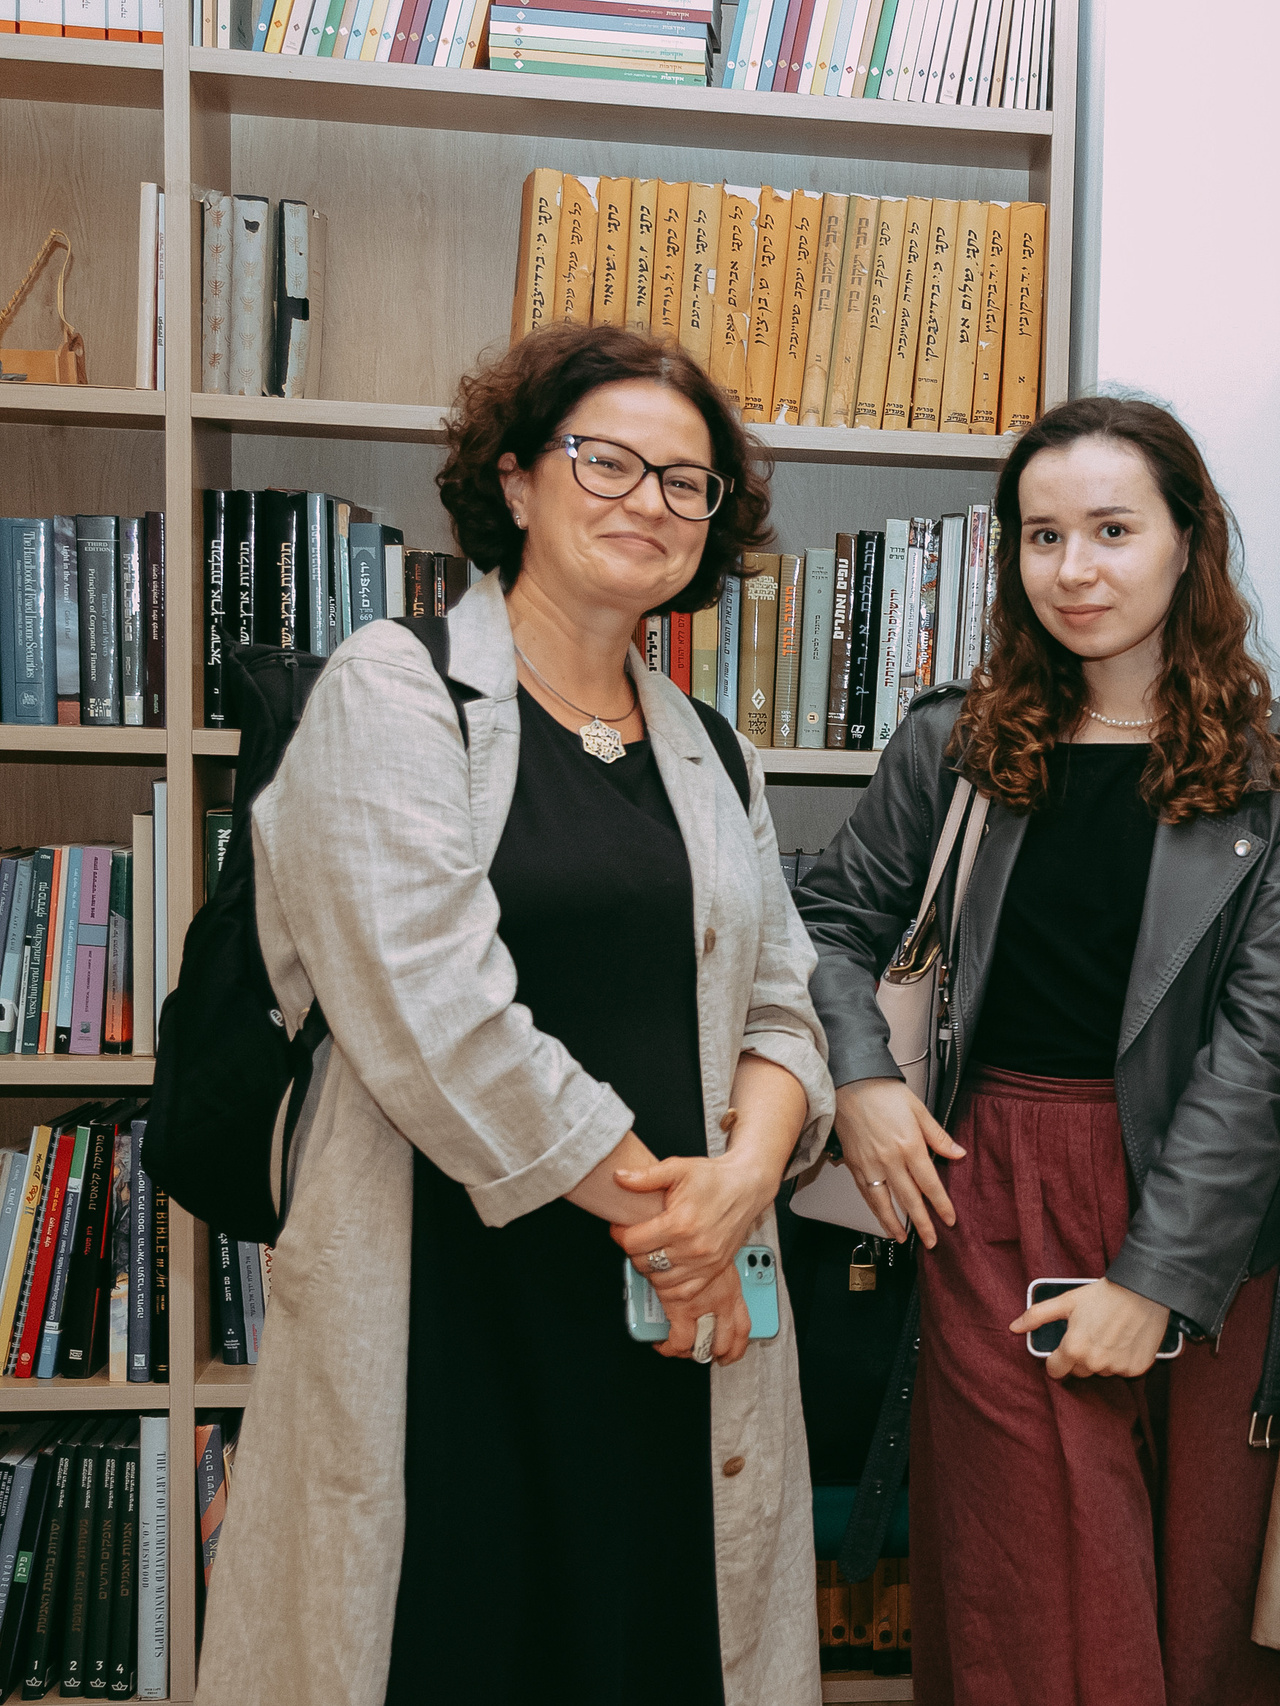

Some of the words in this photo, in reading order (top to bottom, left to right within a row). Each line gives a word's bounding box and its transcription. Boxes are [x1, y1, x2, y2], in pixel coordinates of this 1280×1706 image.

[538, 197, 550, 225] כתבי
[570, 203, 582, 216] כל
[608, 204, 619, 234] כתבי
[640, 206, 652, 235] כתבי
[664, 209, 679, 222] כל
[693, 210, 707, 223] כל
[729, 206, 743, 221] כל
[760, 214, 774, 230] כל
[571, 223, 583, 245] כתבי
[795, 218, 809, 231] כל
[879, 222, 890, 246] כתבי
[909, 222, 920, 236] כל
[666, 229, 679, 258] כתבי
[695, 229, 708, 255] כתבי
[731, 225, 744, 253] כתבי
[761, 237, 775, 268] כתבי
[797, 236, 809, 262] כתבי
[908, 240, 919, 265] כתבי
[936, 227, 949, 255] כתבי
[967, 230, 980, 260] כתבי
[991, 231, 1002, 259] כתבי
[1022, 233, 1035, 260] כתבי
[727, 260, 740, 307] אברהם
[794, 268, 805, 300] יעקב
[875, 256, 886, 287] יעקב
[902, 270, 913, 303] יהודה
[958, 269, 975, 310] שלום
[959, 318, 969, 343] אש
[24, 531, 35, 546] The
[62, 545, 70, 557] Light
[24, 547, 35, 586] Handbook
[208, 539, 222, 588] תולדות
[237, 541, 250, 588] תולדות
[277, 542, 292, 588] תולדות
[838, 559, 848, 589] נופים
[25, 585, 36, 593] of
[88, 568, 96, 602] Principles
[124, 554, 133, 641] INTELLIGENCE
[359, 562, 370, 607] ירושלים
[25, 593, 36, 613] Fixed
[90, 605, 98, 613] of
[883, 589, 899, 625] ירושלים
[25, 616, 36, 641] Income
[833, 594, 846, 640] ואתרים
[89, 614, 97, 651] Corporate
[677, 631, 685, 644] ללא
[883, 627, 896, 643] וכל
[905, 627, 914, 648] Artists
[25, 641, 37, 678] Securities
[905, 650, 914, 667] Paper
[32, 923, 44, 965] Landschap
[27, 966, 40, 1018] Verschuivend
[92, 1135, 105, 1170] מוסיקה
[88, 1172, 101, 1211] קלאסית
[137, 1170, 145, 1193] לייסוד
[156, 1211, 168, 1253] BIBLE
[218, 1232, 228, 1245] לא
[59, 1240, 67, 1253] Israel
[137, 1237, 145, 1265] הריאלי
[52, 1275, 61, 1300] Sculptures
[137, 1266, 145, 1292] העברי
[49, 1301, 57, 1320] Outdoor
[137, 1293, 145, 1319] בחיפה
[157, 1452, 166, 1472] THE
[205, 1448, 213, 1471] נסים
[156, 1475, 166, 1496] ART
[205, 1475, 215, 1503] משעל
[156, 1498, 165, 1511] OF
[101, 1519, 112, 1559] אופקים
[142, 1530, 150, 1538] O.
[155, 1513, 165, 1582] ILLUMINATED
[43, 1557, 56, 1591] בהבנת
[142, 1541, 150, 1588] WESTWOOD
[98, 1563, 109, 1600] חדשים
[154, 1586, 164, 1658] MANUSCRIPTS
[33, 1660, 39, 1670] 1
[69, 1661, 78, 1670] 2
[96, 1661, 103, 1670] 3
[116, 1663, 124, 1674] 4
